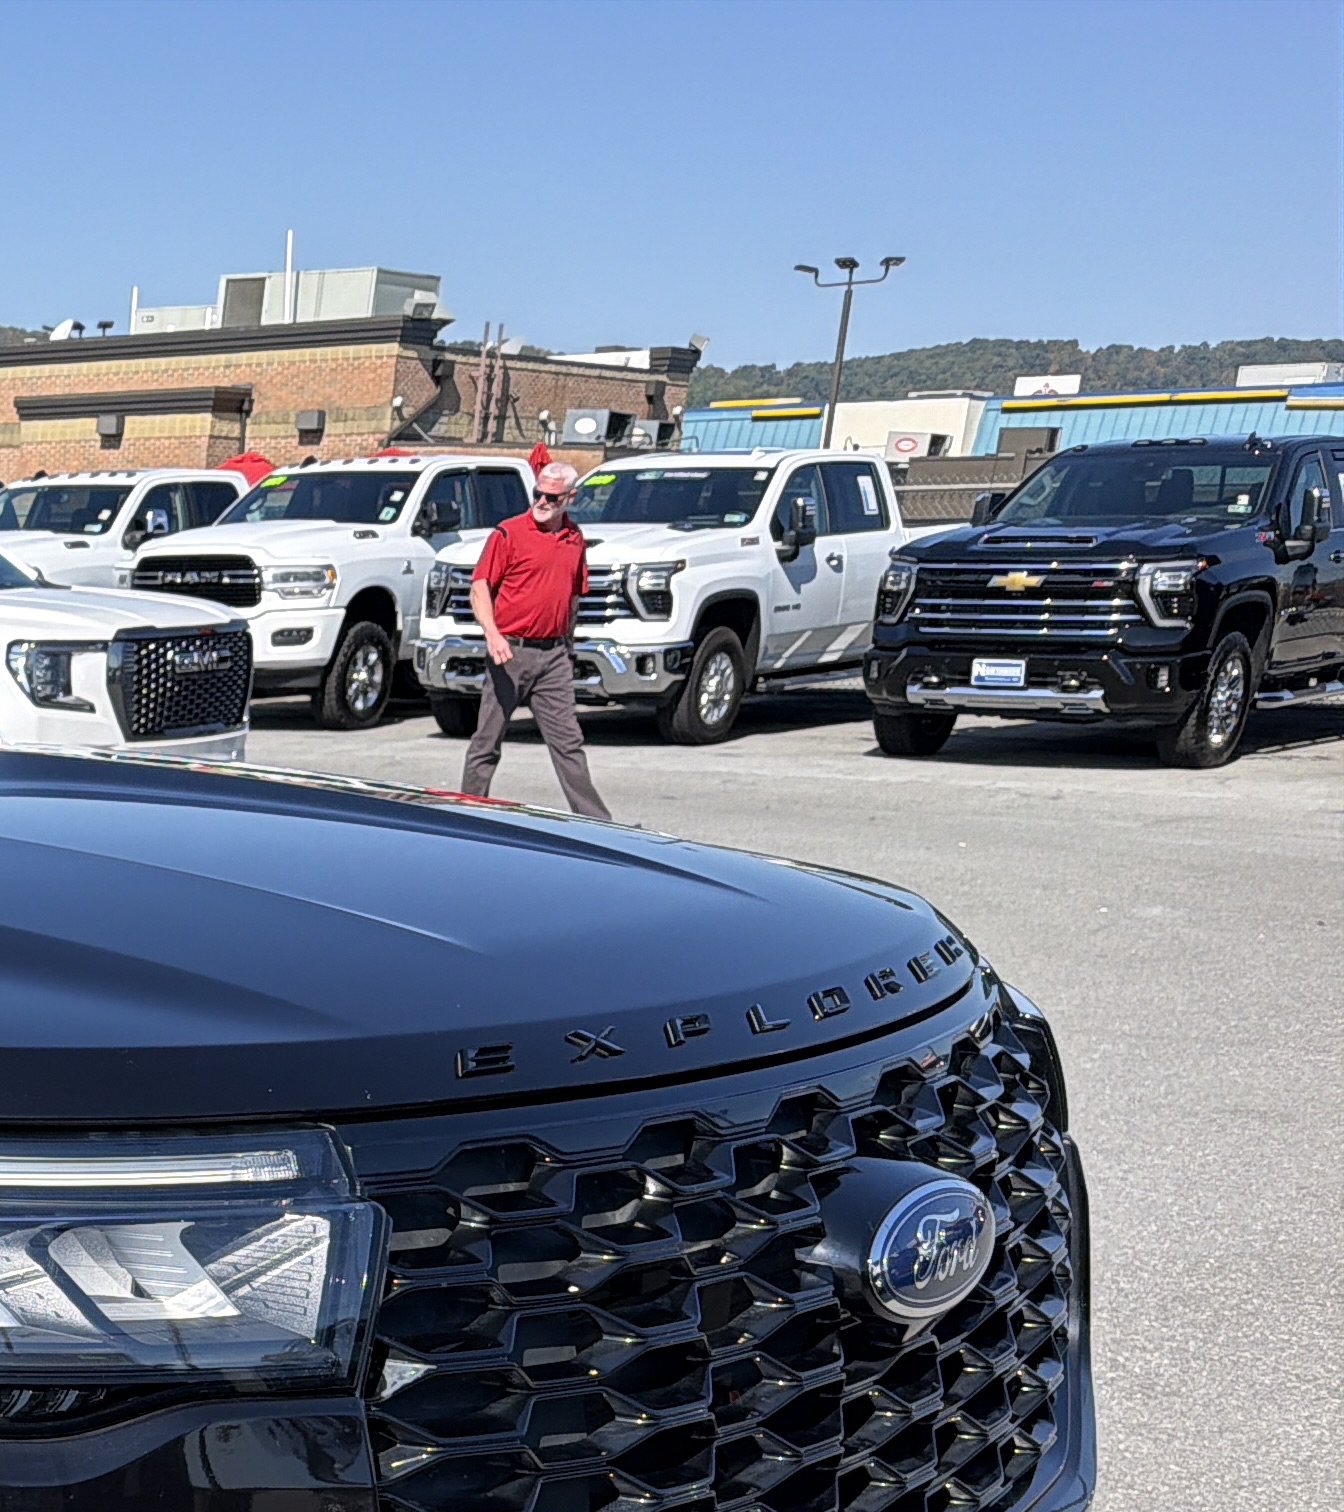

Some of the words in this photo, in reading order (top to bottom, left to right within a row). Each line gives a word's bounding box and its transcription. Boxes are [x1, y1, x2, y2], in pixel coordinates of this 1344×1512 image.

[163, 571, 220, 584] RAM
[174, 648, 232, 674] GMC
[454, 934, 964, 1080] EXPLORER
[913, 1207, 979, 1290] Ford
